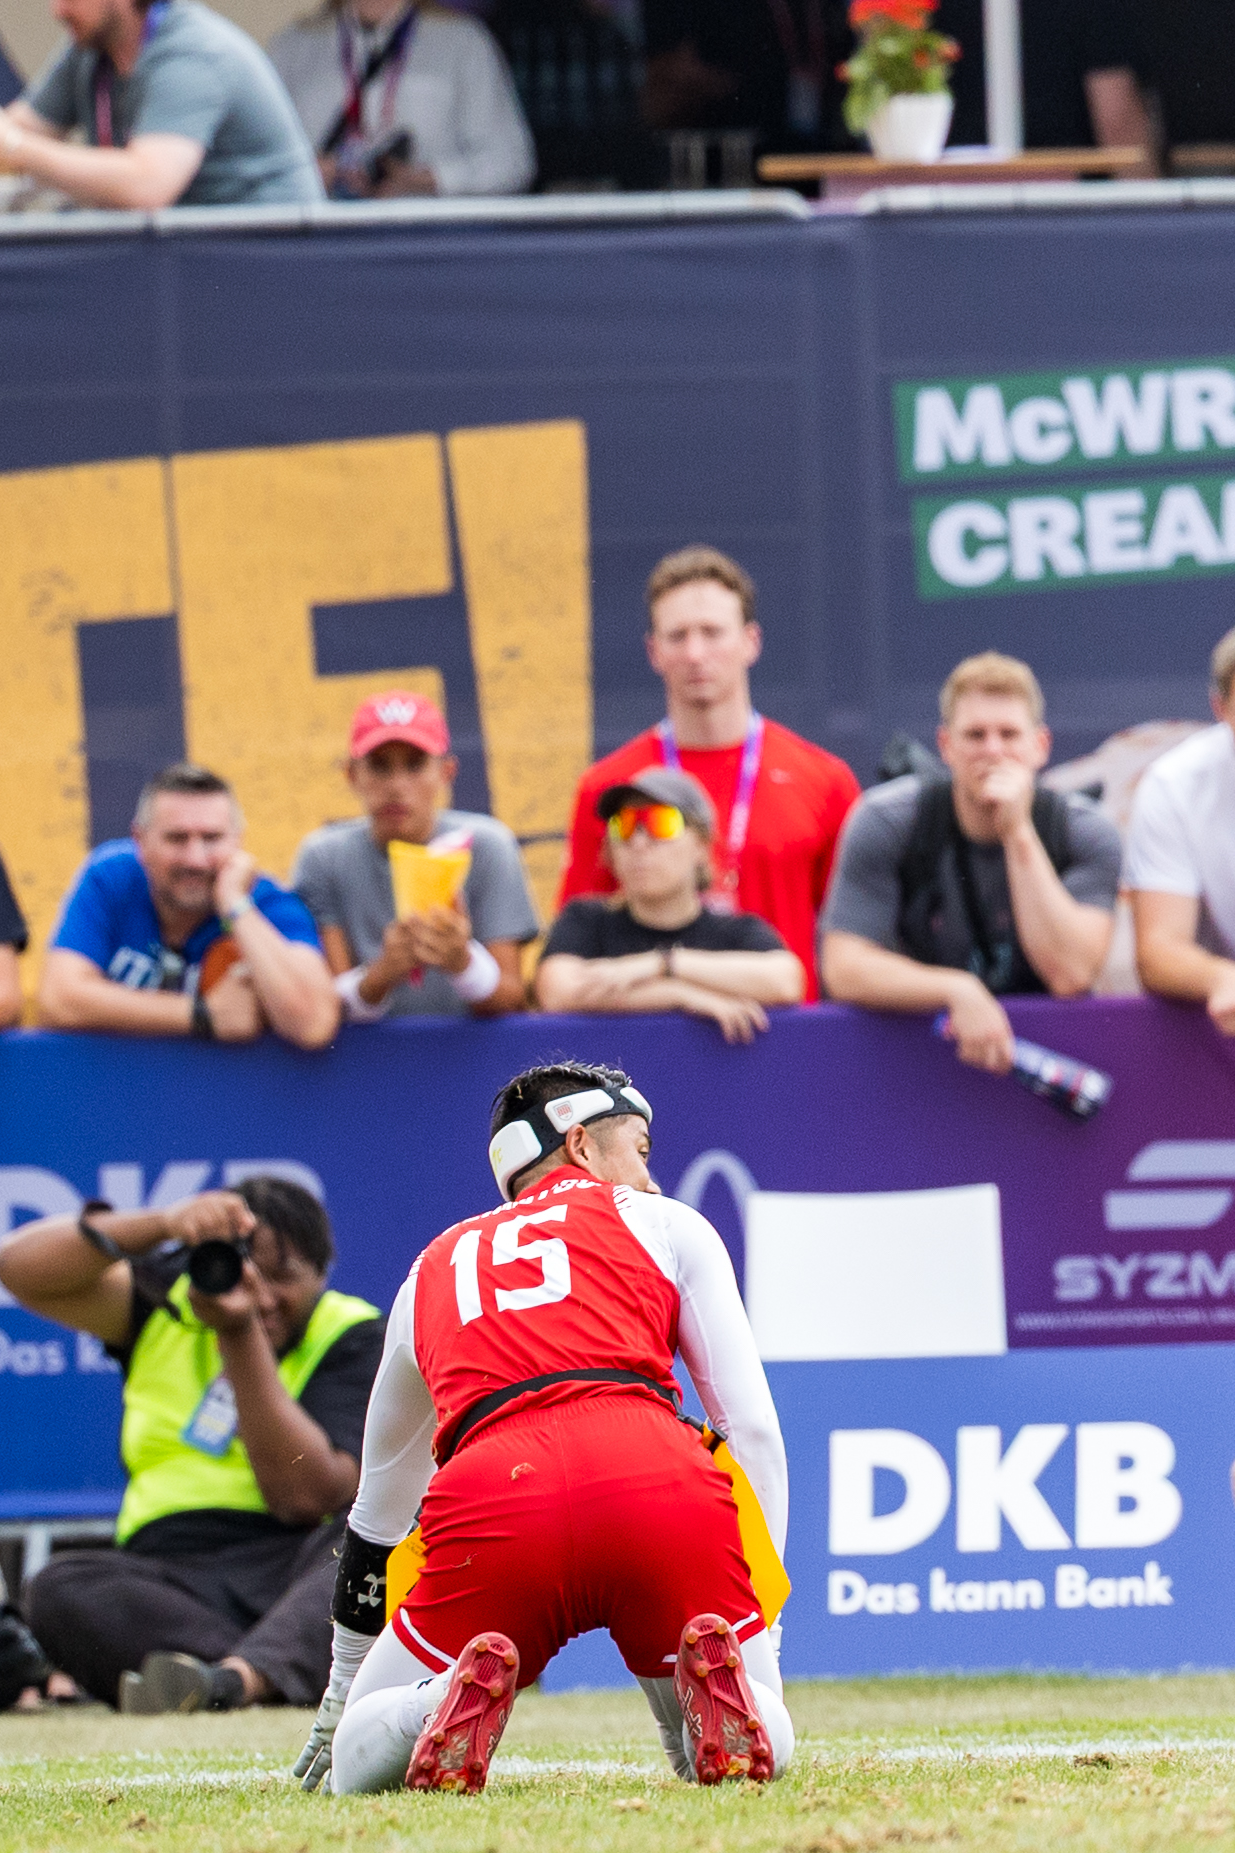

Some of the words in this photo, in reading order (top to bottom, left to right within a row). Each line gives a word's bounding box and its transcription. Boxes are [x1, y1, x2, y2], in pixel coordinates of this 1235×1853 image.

[927, 480, 1235, 588] CREA
[449, 1203, 572, 1326] 15
[829, 1420, 1183, 1556] DKB
[827, 1568, 921, 1616] Das
[929, 1566, 1046, 1613] kann
[1055, 1560, 1174, 1609] Bank
